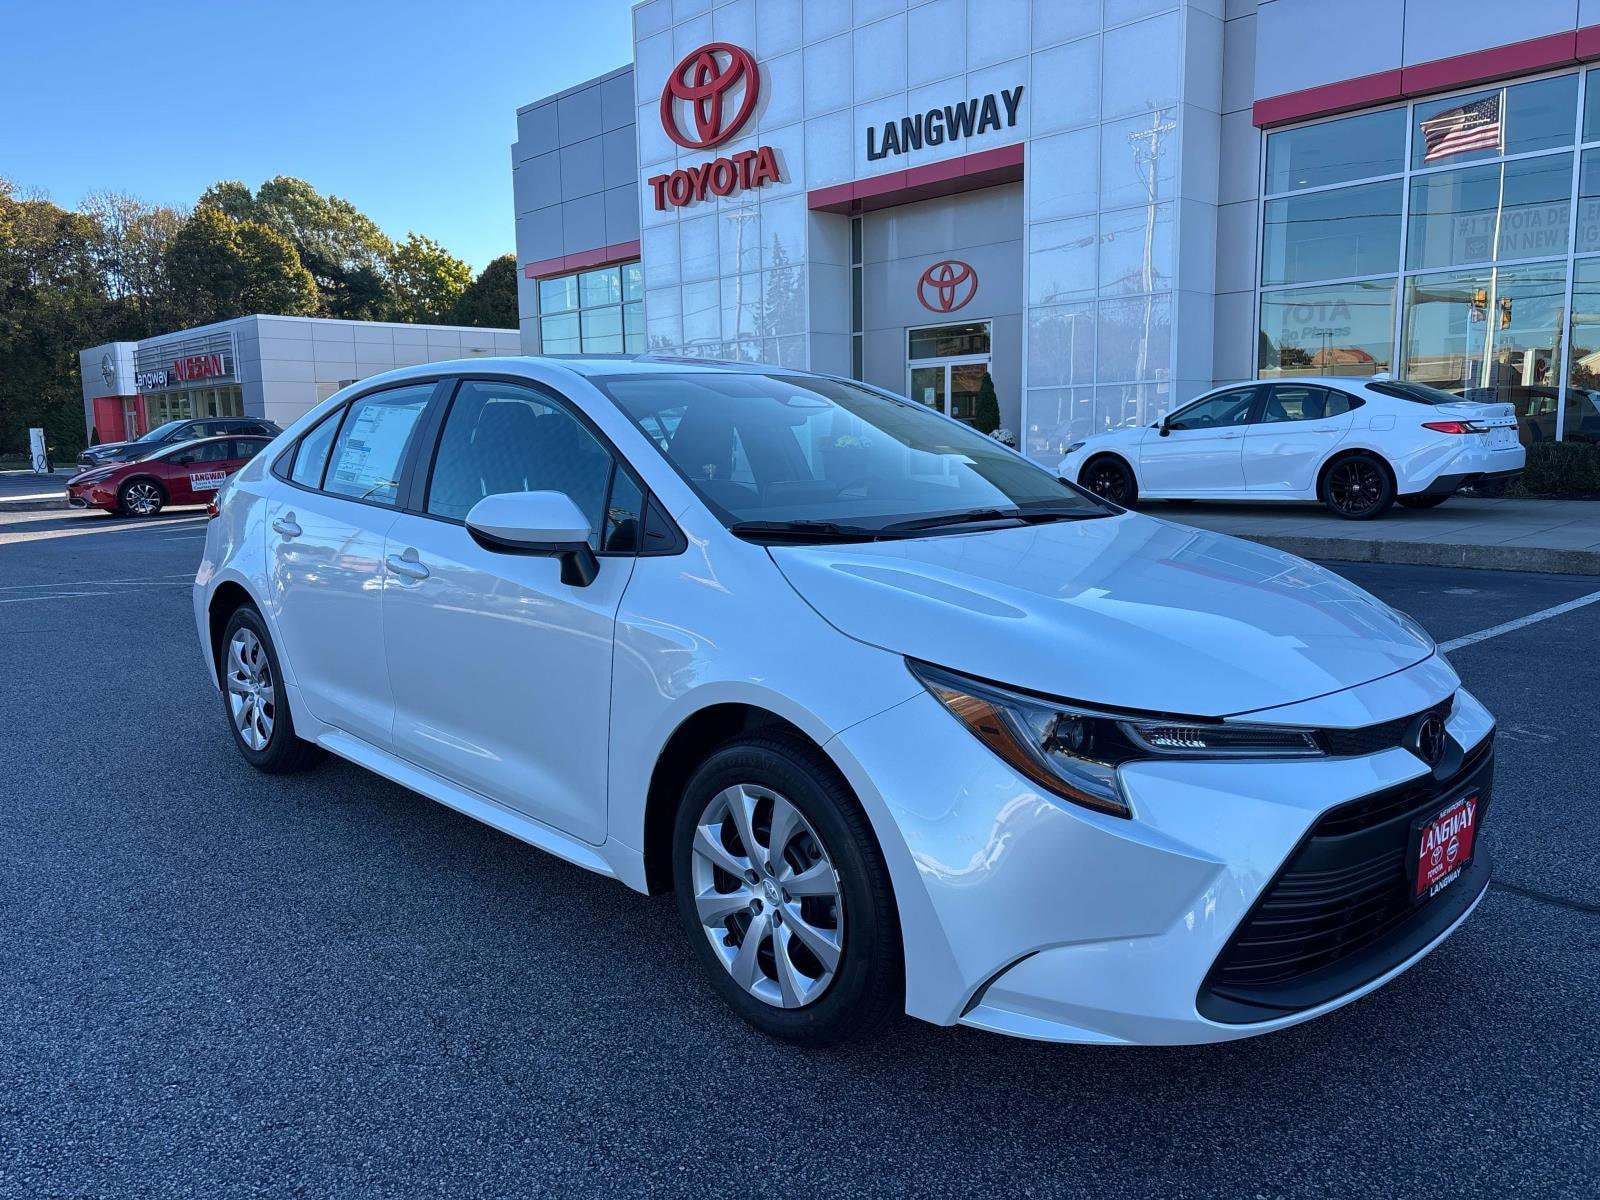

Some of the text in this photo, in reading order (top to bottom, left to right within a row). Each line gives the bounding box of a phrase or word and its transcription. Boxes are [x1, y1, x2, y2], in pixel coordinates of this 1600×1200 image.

[867, 86, 1024, 161] LANGWAY
[648, 145, 781, 211] TOYOTA
[1522, 231, 1563, 250] NEW
[135, 370, 169, 389] Langway
[173, 353, 226, 381] NISSAN
[191, 471, 226, 481] LANGWAY
[1420, 804, 1476, 858] LANGWAY
[1430, 867, 1461, 897] LANGWAY
